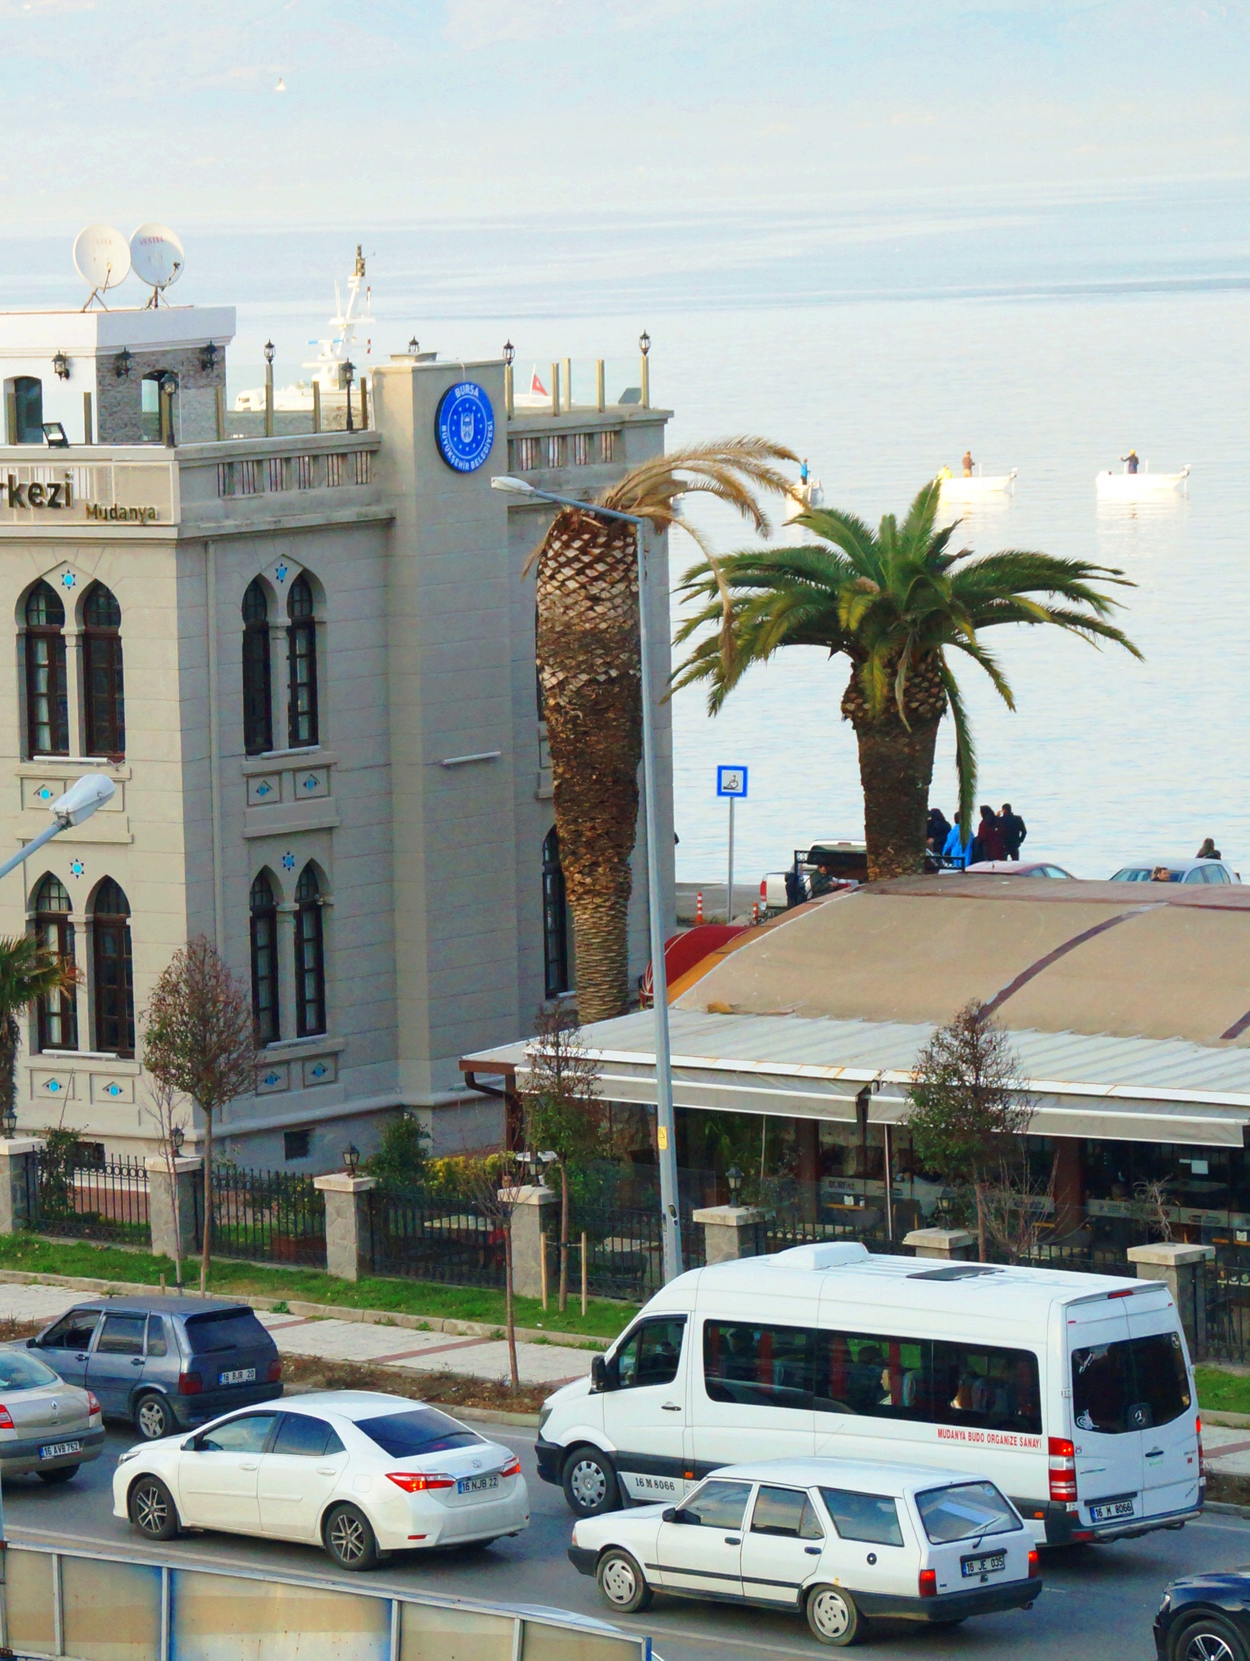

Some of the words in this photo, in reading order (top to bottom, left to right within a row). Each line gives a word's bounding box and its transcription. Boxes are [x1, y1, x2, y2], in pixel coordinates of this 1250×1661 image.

[454, 384, 479, 398] BURSA
[85, 502, 160, 525] Mudanya
[223, 1373, 230, 1382] 16
[937, 1428, 966, 1441] MUDANYA
[968, 1431, 985, 1443] BUDO
[44, 1446, 53, 1456] 16
[462, 1481, 470, 1492] 16
[471, 1479, 487, 1490] NJB
[488, 1477, 498, 1487] 22
[635, 1477, 644, 1487] 16
[645, 1478, 653, 1489] M
[654, 1480, 675, 1491] 8066
[1095, 1507, 1103, 1518] 16
[1105, 1505, 1112, 1516] M
[1115, 1502, 1131, 1514] 8066
[966, 1562, 975, 1572] 16
[978, 1560, 987, 1571] JE
[990, 1556, 1004, 1568] 035
